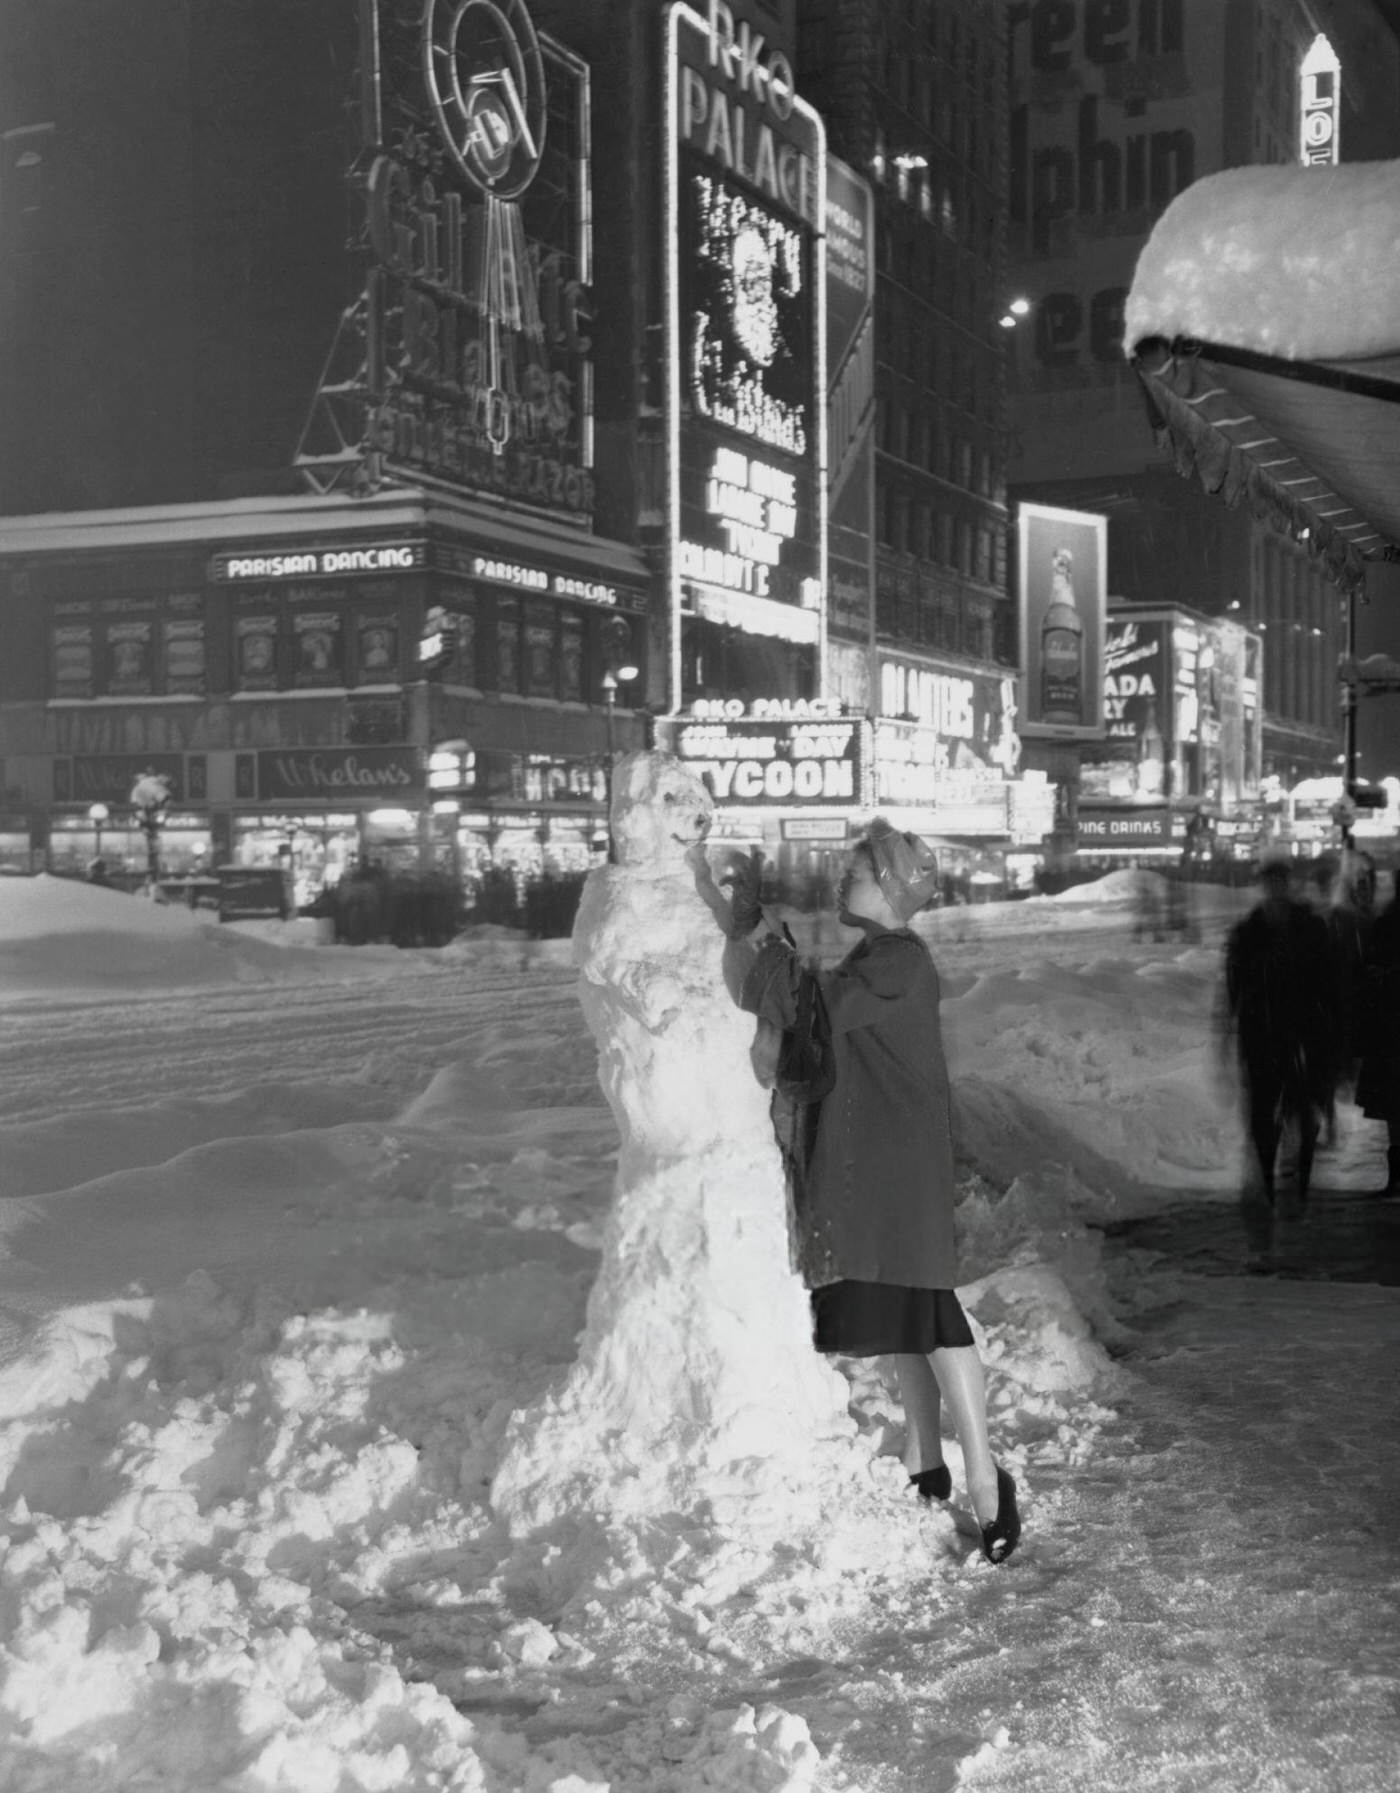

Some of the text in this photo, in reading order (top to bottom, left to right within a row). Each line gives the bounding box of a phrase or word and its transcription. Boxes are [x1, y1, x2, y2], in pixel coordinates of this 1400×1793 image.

[709, 0, 794, 121] RKO
[683, 65, 817, 224] PALACE
[228, 547, 414, 578] PARISIAN DANCING
[474, 557, 617, 605] PARISIAN DANCING
[753, 698, 841, 717] PALACE
[1109, 722, 1136, 736] ALE
[792, 737, 849, 758] DAY
[277, 754, 411, 787] Whelan's
[1110, 820, 1161, 834] DRINKS
